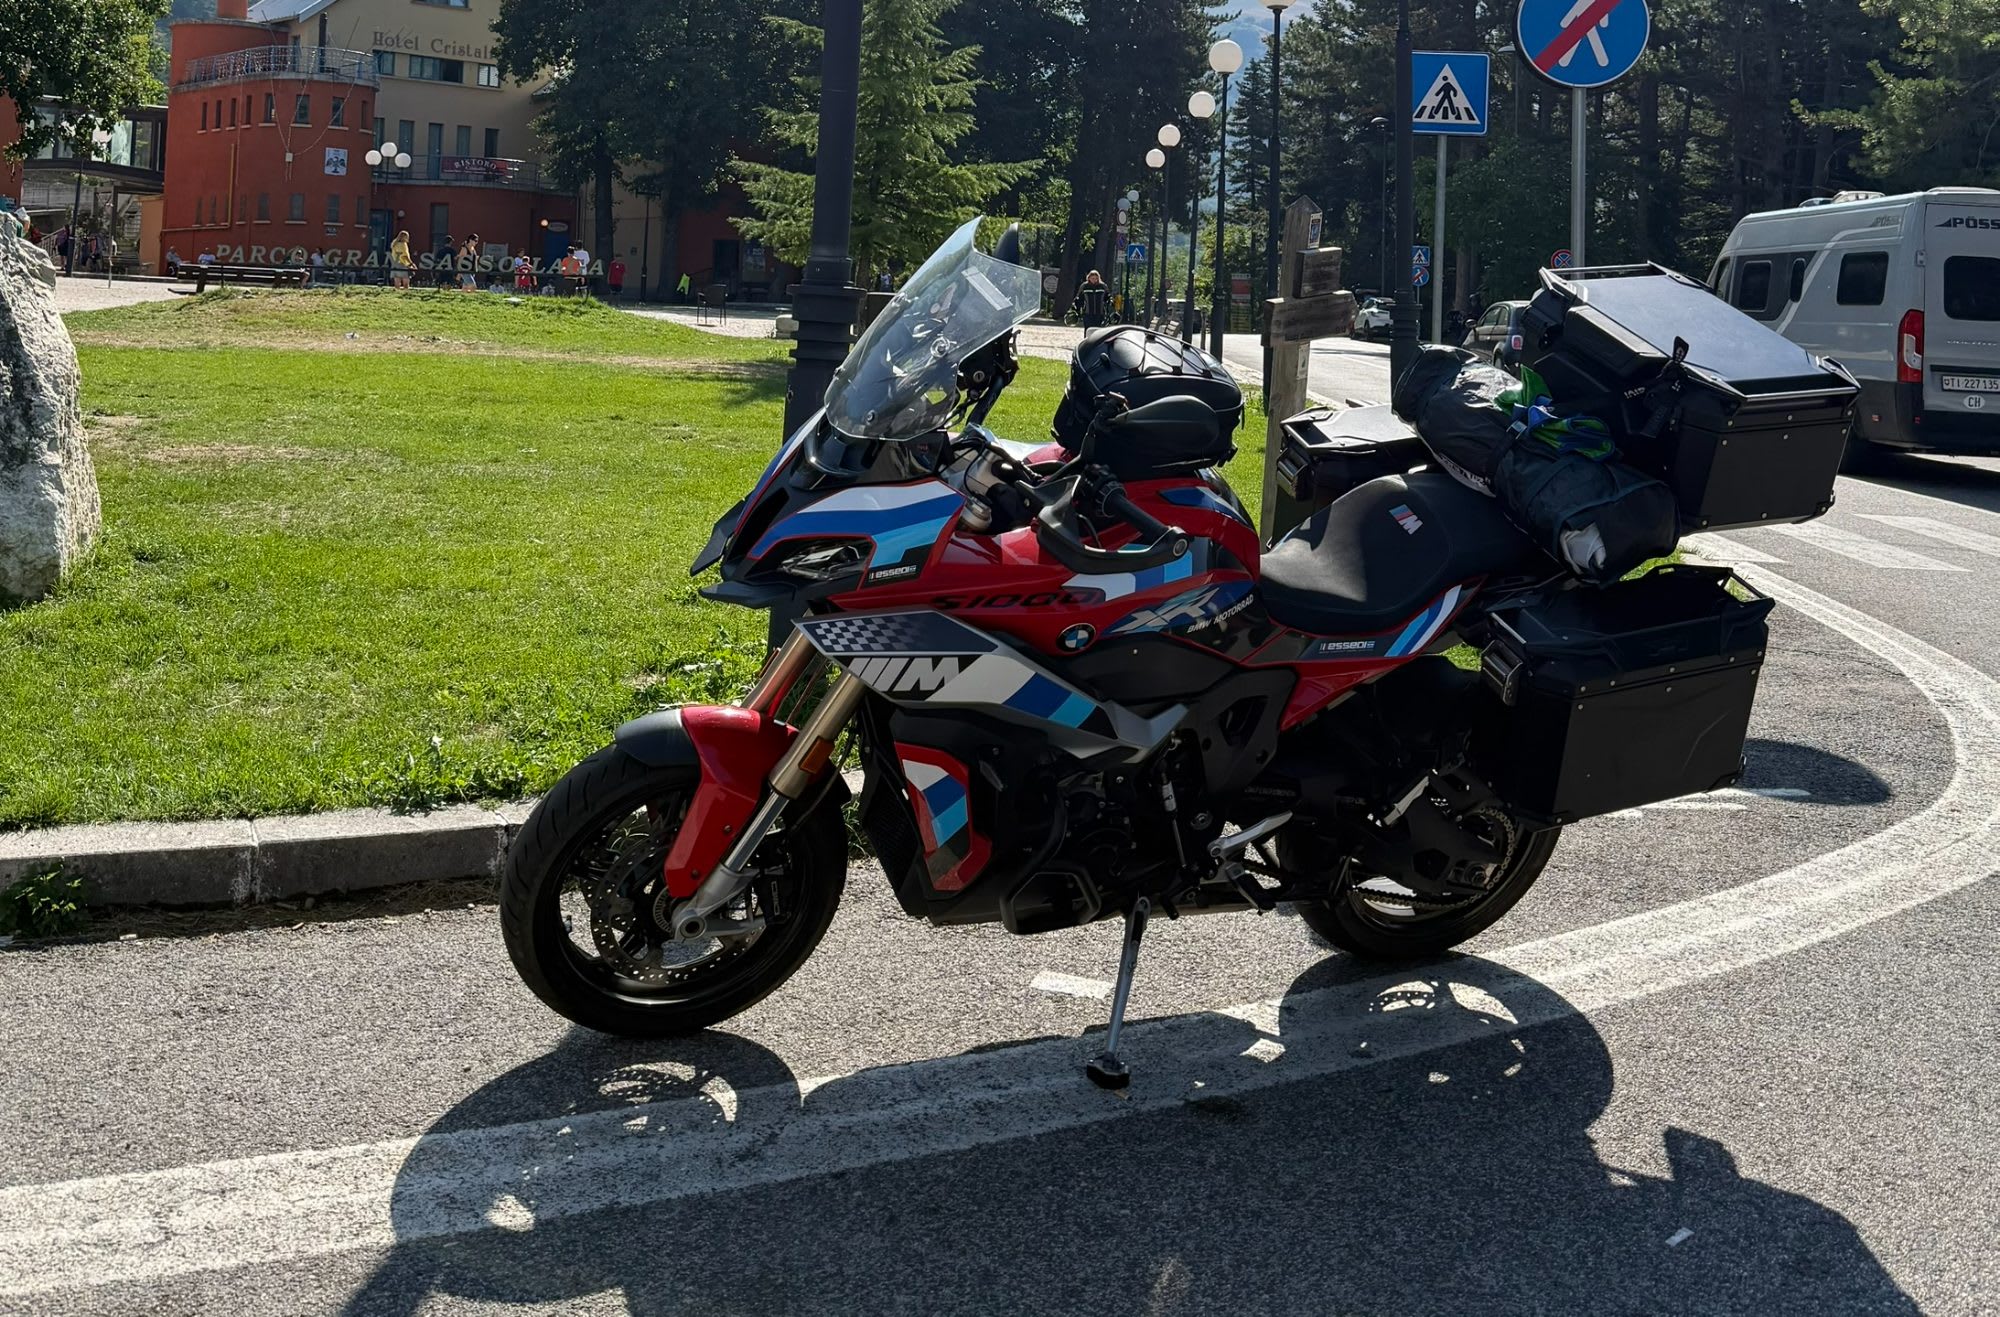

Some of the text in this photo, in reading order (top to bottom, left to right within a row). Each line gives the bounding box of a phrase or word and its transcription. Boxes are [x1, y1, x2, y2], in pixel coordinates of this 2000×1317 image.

[372, 31, 494, 60] Hotel Cristal
[454, 159, 497, 169] RISTORO
[217, 244, 309, 265] PARCO
[419, 252, 514, 273] SASSO
[531, 257, 604, 276] LAA
[1951, 378, 1960, 388] TI
[1968, 396, 1981, 407] CH
[1187, 594, 1254, 633] BMW MOTORRAD
